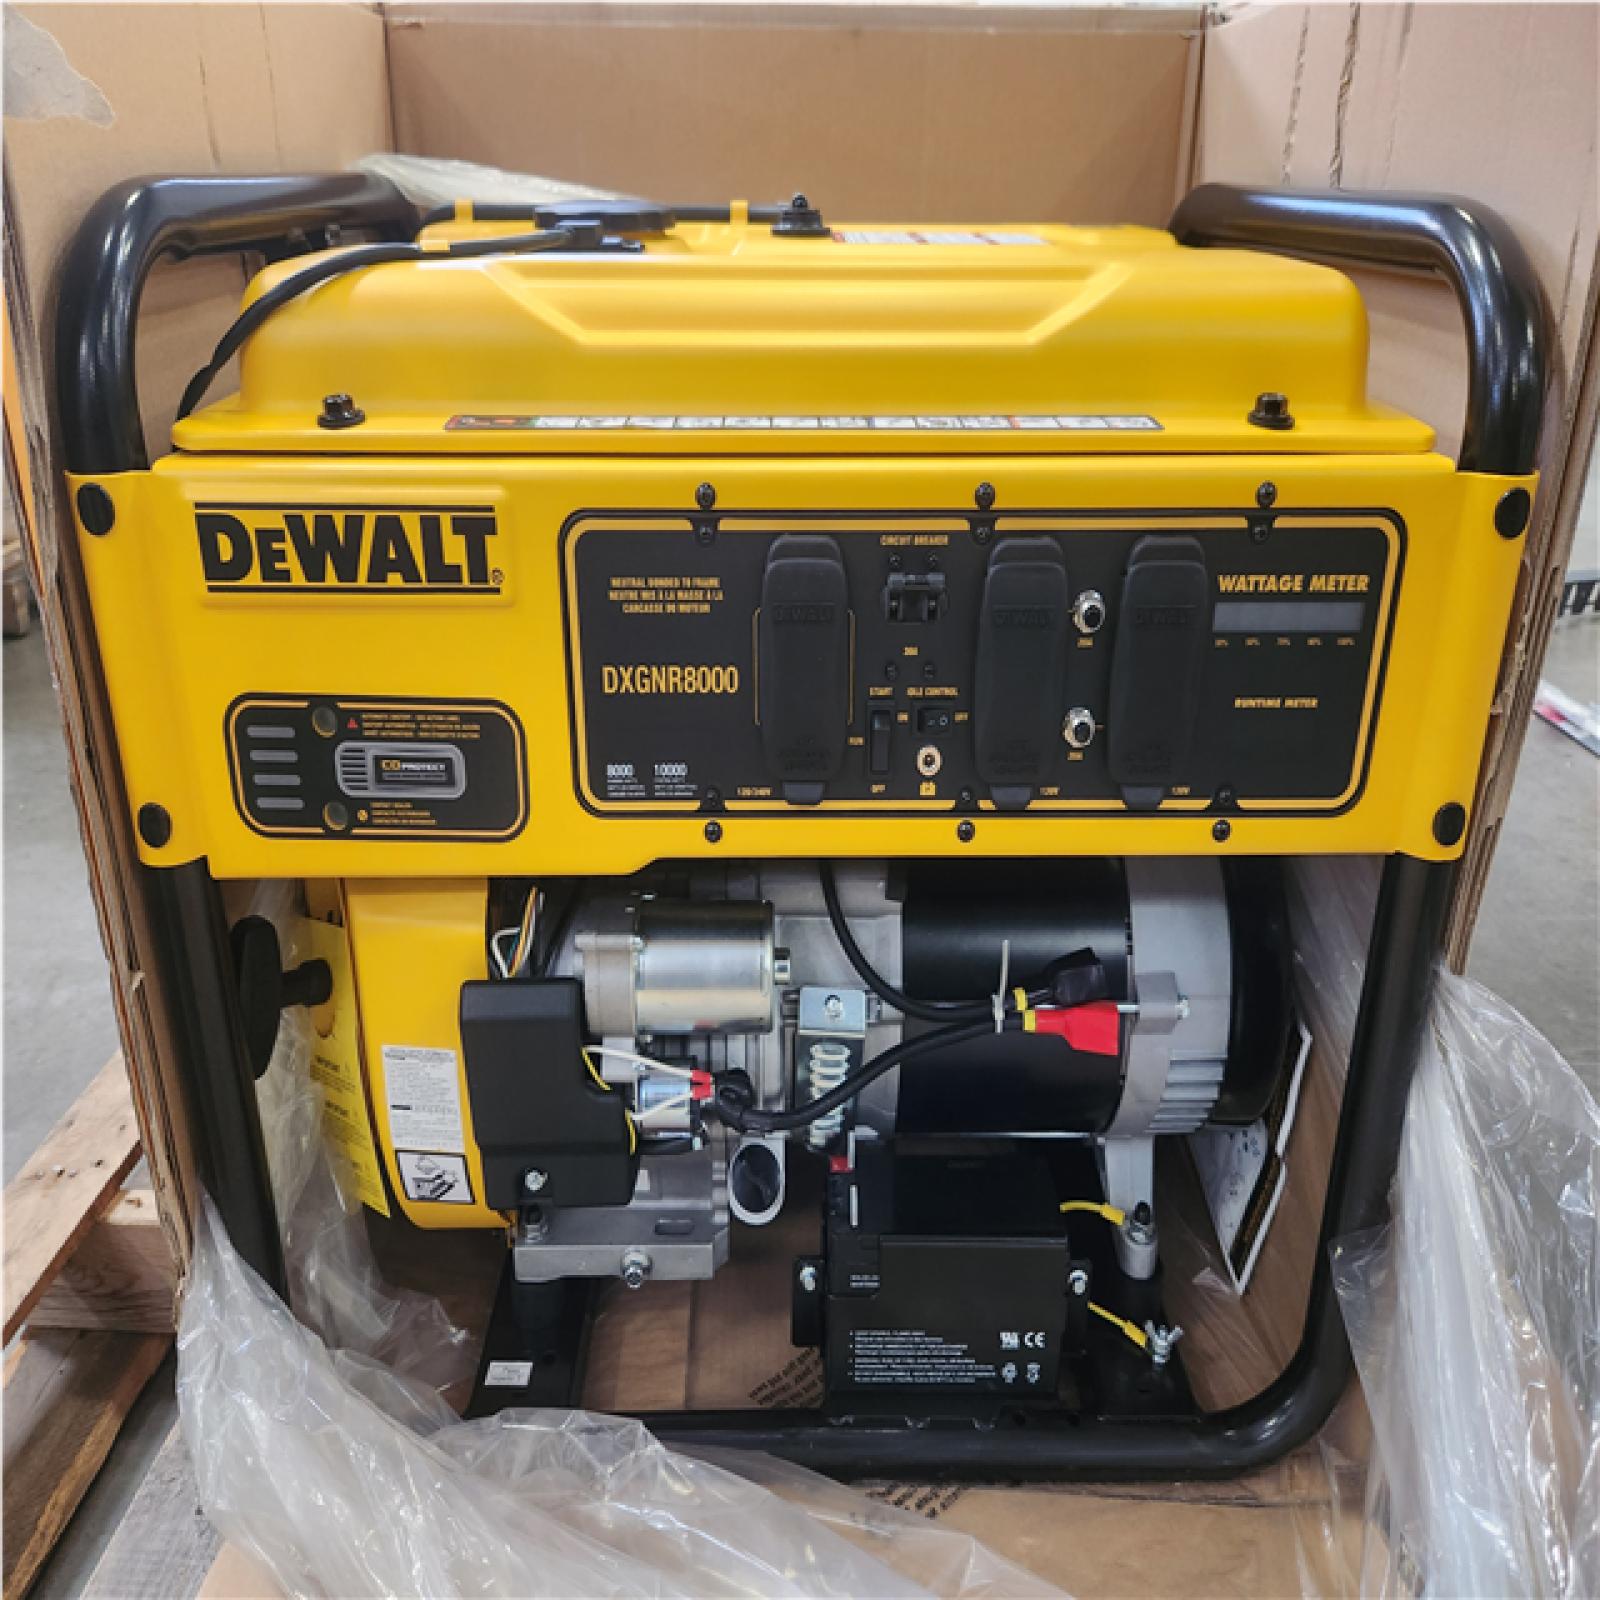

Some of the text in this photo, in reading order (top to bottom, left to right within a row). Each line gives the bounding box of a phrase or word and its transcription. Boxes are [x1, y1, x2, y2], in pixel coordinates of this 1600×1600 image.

[195, 512, 499, 585] DEWALT
[914, 534, 949, 546] BREAKER
[1218, 574, 1370, 592] WATTAGE METER
[602, 665, 740, 694] DXGNR8000
